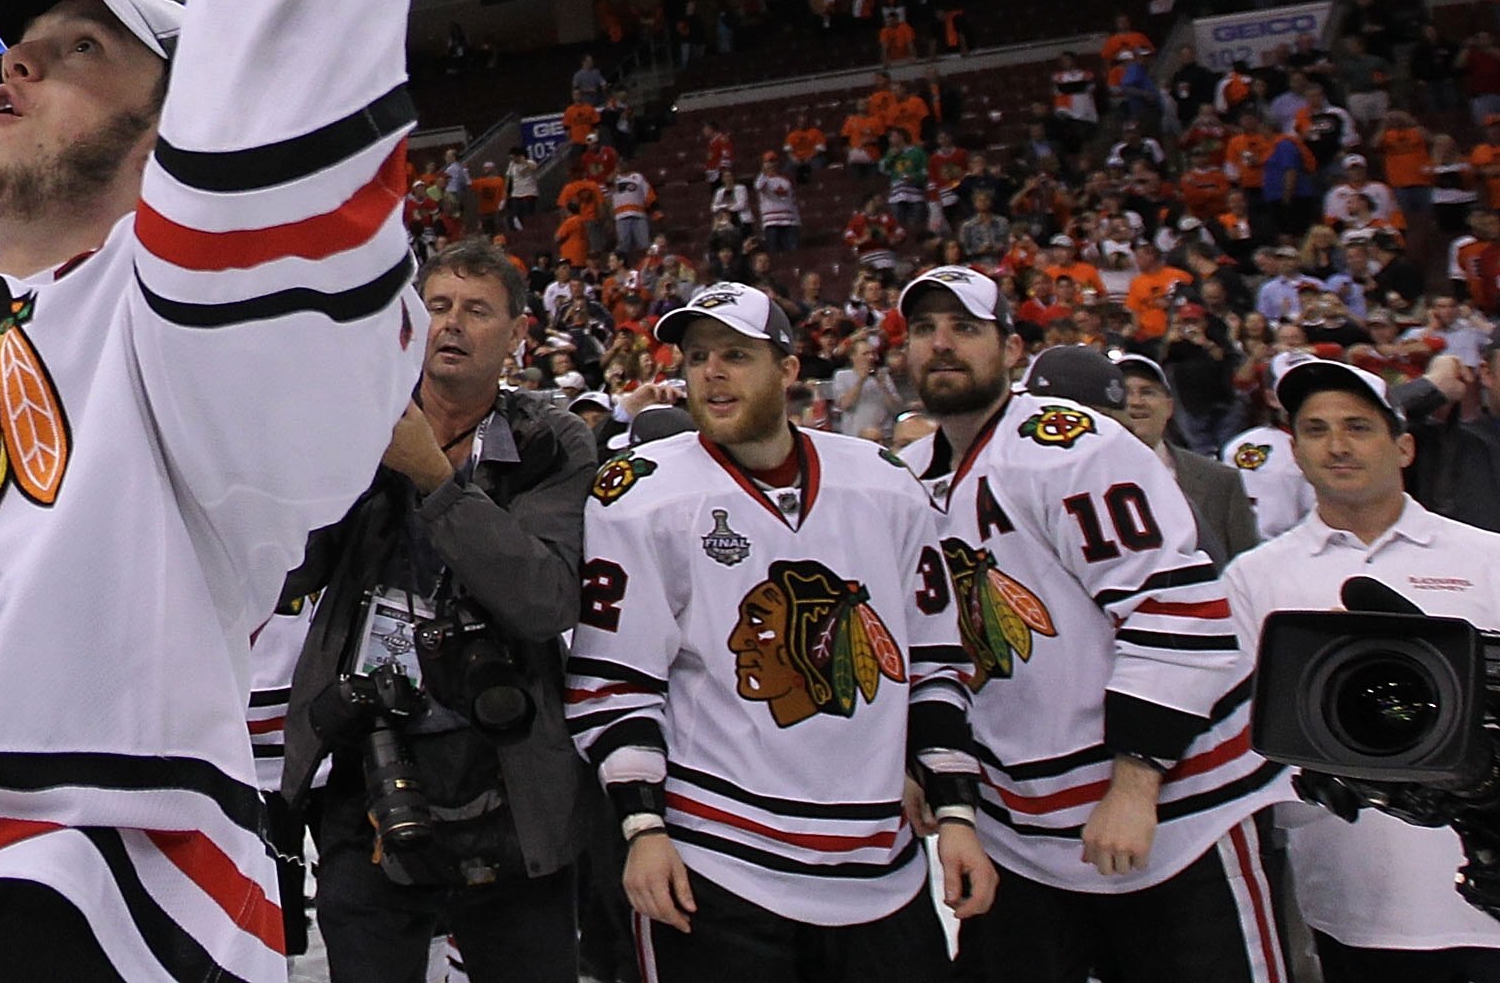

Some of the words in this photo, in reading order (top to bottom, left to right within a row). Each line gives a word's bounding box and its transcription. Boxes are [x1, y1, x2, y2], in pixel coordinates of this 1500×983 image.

[1213, 14, 1317, 42] GEICO
[976, 475, 1016, 543] A
[1062, 482, 1164, 564] 10
[704, 538, 748, 548] FINAL
